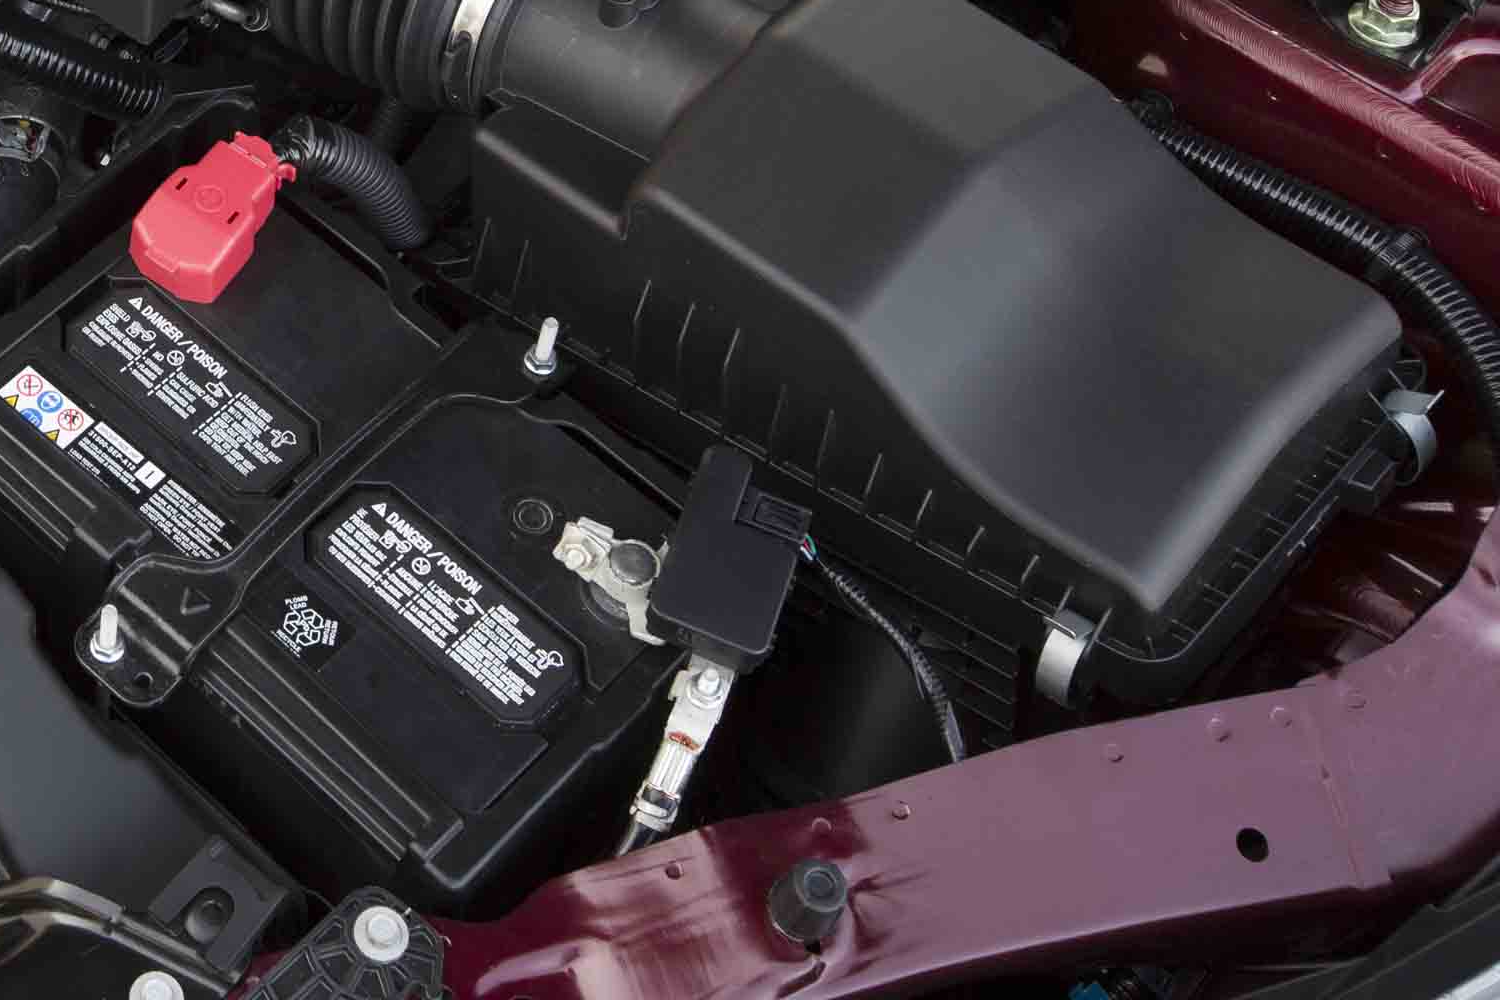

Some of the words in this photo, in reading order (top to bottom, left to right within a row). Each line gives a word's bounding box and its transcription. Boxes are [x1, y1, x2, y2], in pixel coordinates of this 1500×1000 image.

[109, 303, 132, 322] SHIELD
[140, 305, 185, 342] DANGER
[186, 344, 229, 379] POISON
[176, 372, 207, 397] SULFURIC
[202, 394, 220, 409] ACID
[385, 512, 434, 554] DANGER
[436, 556, 483, 596] POISON
[290, 602, 307, 610] LEAD
